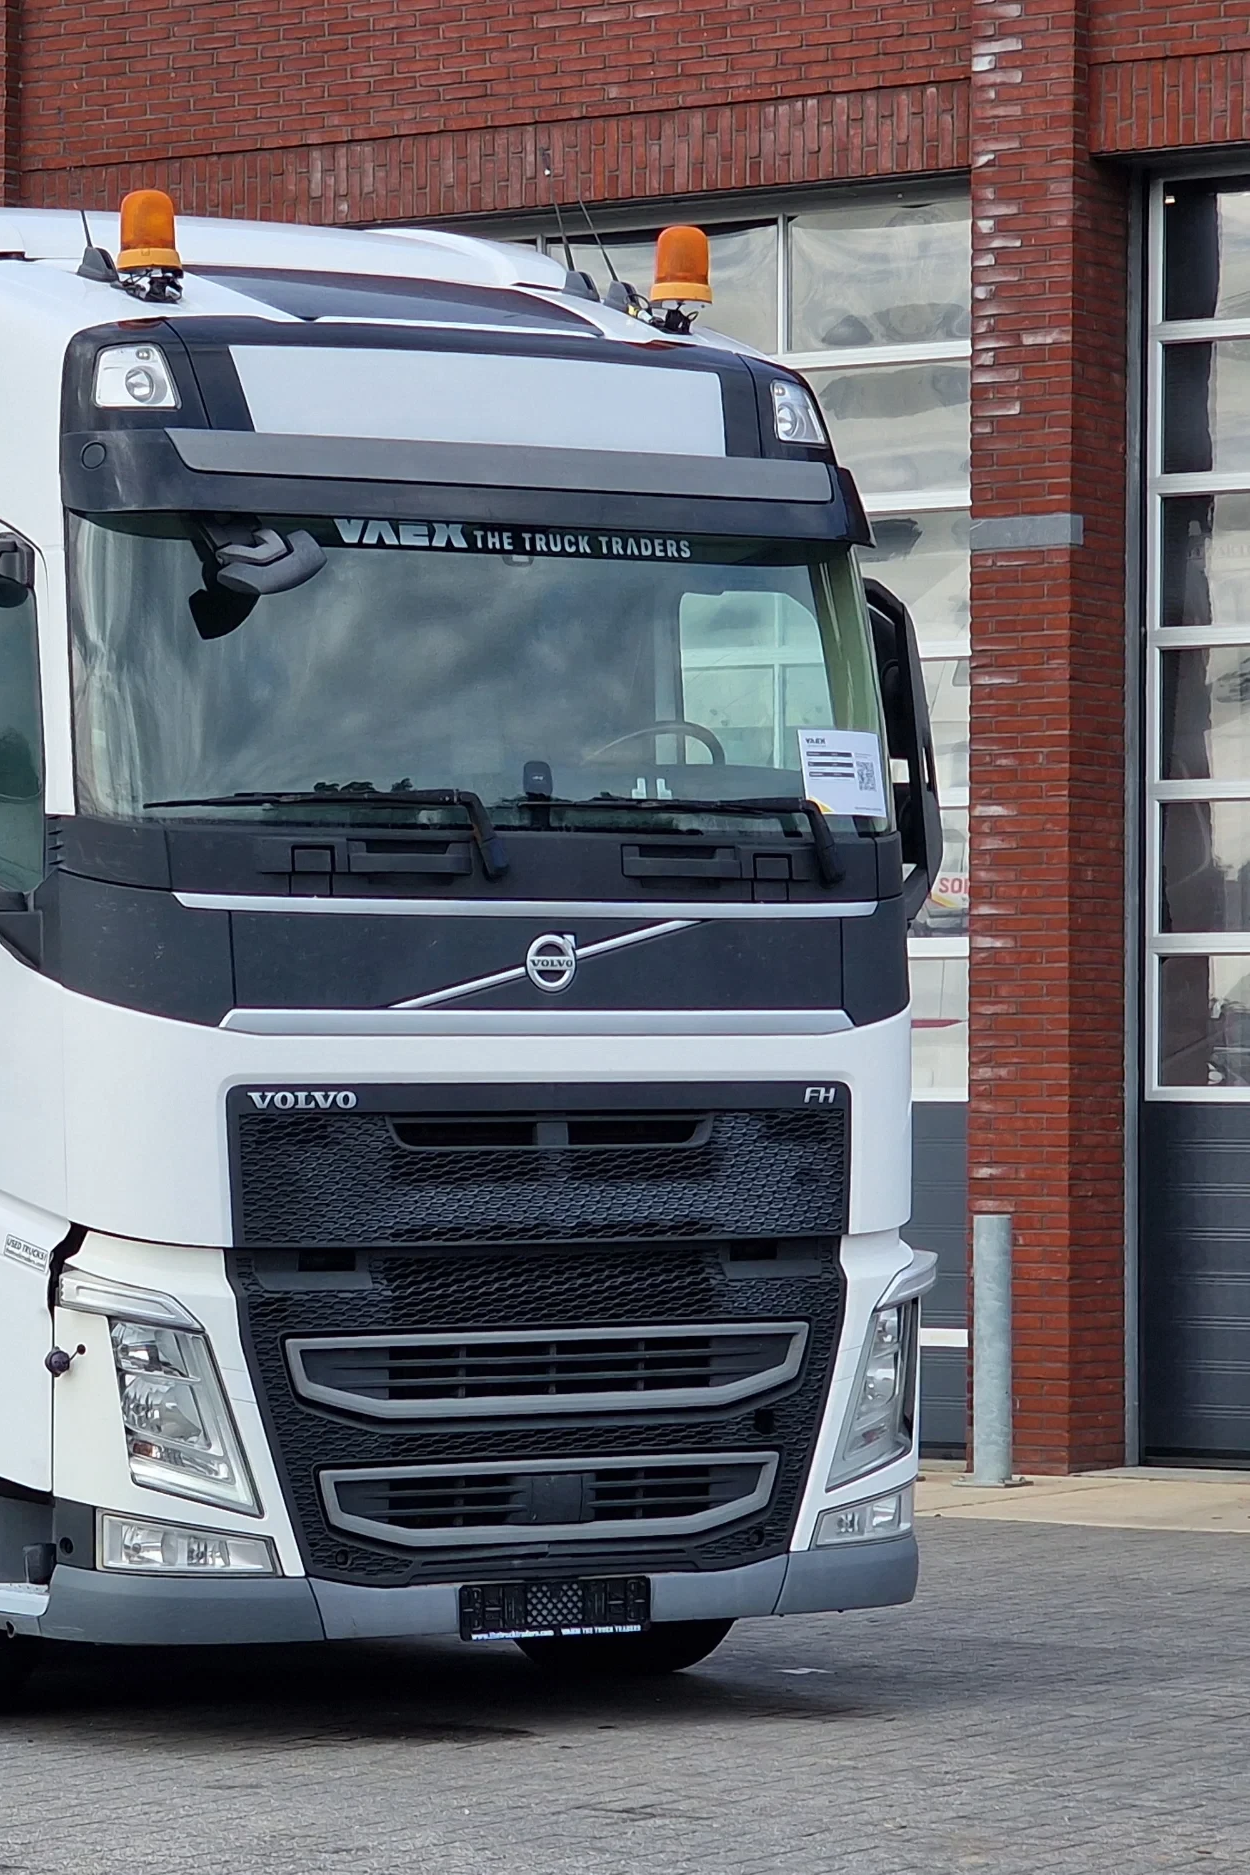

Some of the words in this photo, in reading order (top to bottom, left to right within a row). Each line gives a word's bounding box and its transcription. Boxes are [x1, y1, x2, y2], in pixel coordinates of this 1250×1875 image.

[333, 519, 469, 548] VAEX
[473, 530, 514, 550] THE
[521, 532, 592, 554] TRUCK
[598, 535, 692, 558] TRADERS
[531, 959, 573, 968] VOLVO
[247, 1090, 358, 1110] VOLVO
[803, 1087, 836, 1104] FH
